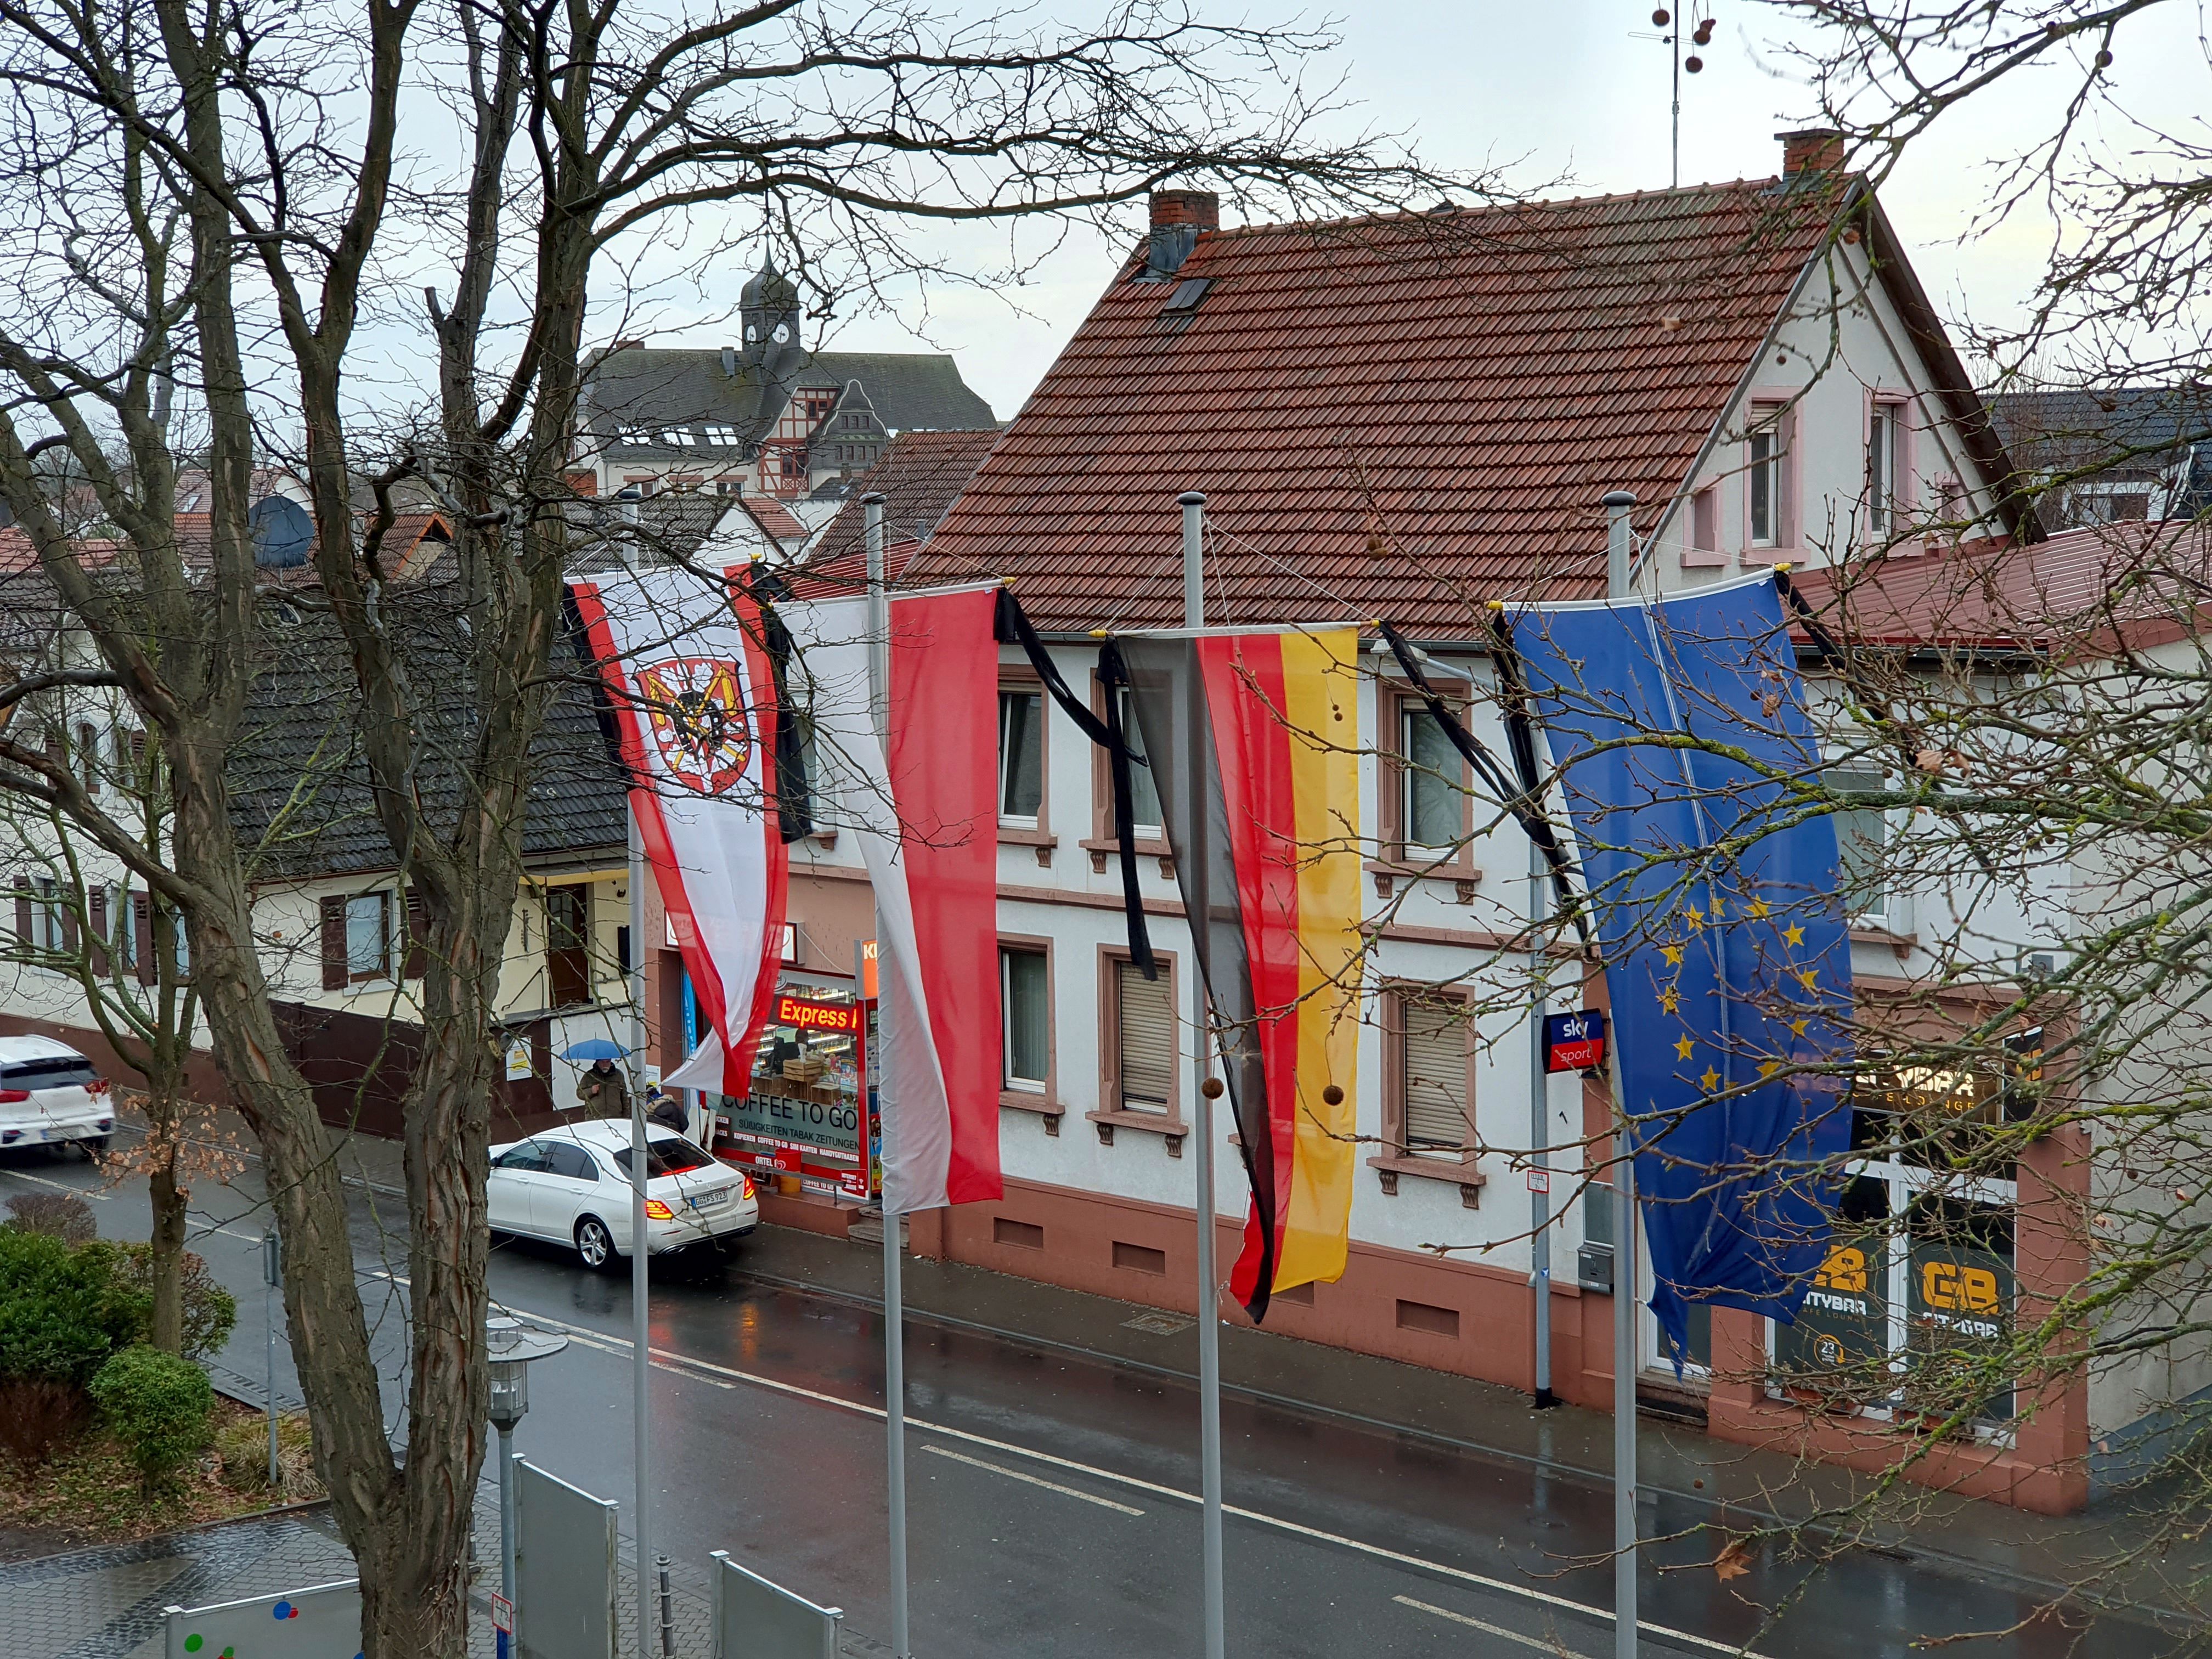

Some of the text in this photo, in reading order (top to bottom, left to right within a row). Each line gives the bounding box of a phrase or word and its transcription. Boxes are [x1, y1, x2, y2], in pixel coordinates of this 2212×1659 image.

[780, 999, 848, 1028] Express
[1563, 1019, 1589, 1039] sky
[1561, 1048, 1592, 1063] sport
[722, 1092, 857, 1131] COFFEE TO GO
[758, 1136, 774, 1146] COFFEE
[789, 1128, 814, 1142] TABAK
[815, 1133, 860, 1150] ZEITUNGEN
[755, 1156, 773, 1167] ORTEL
[715, 1192, 726, 1201] 923
[1802, 1291, 1866, 1315] ITYBAR
